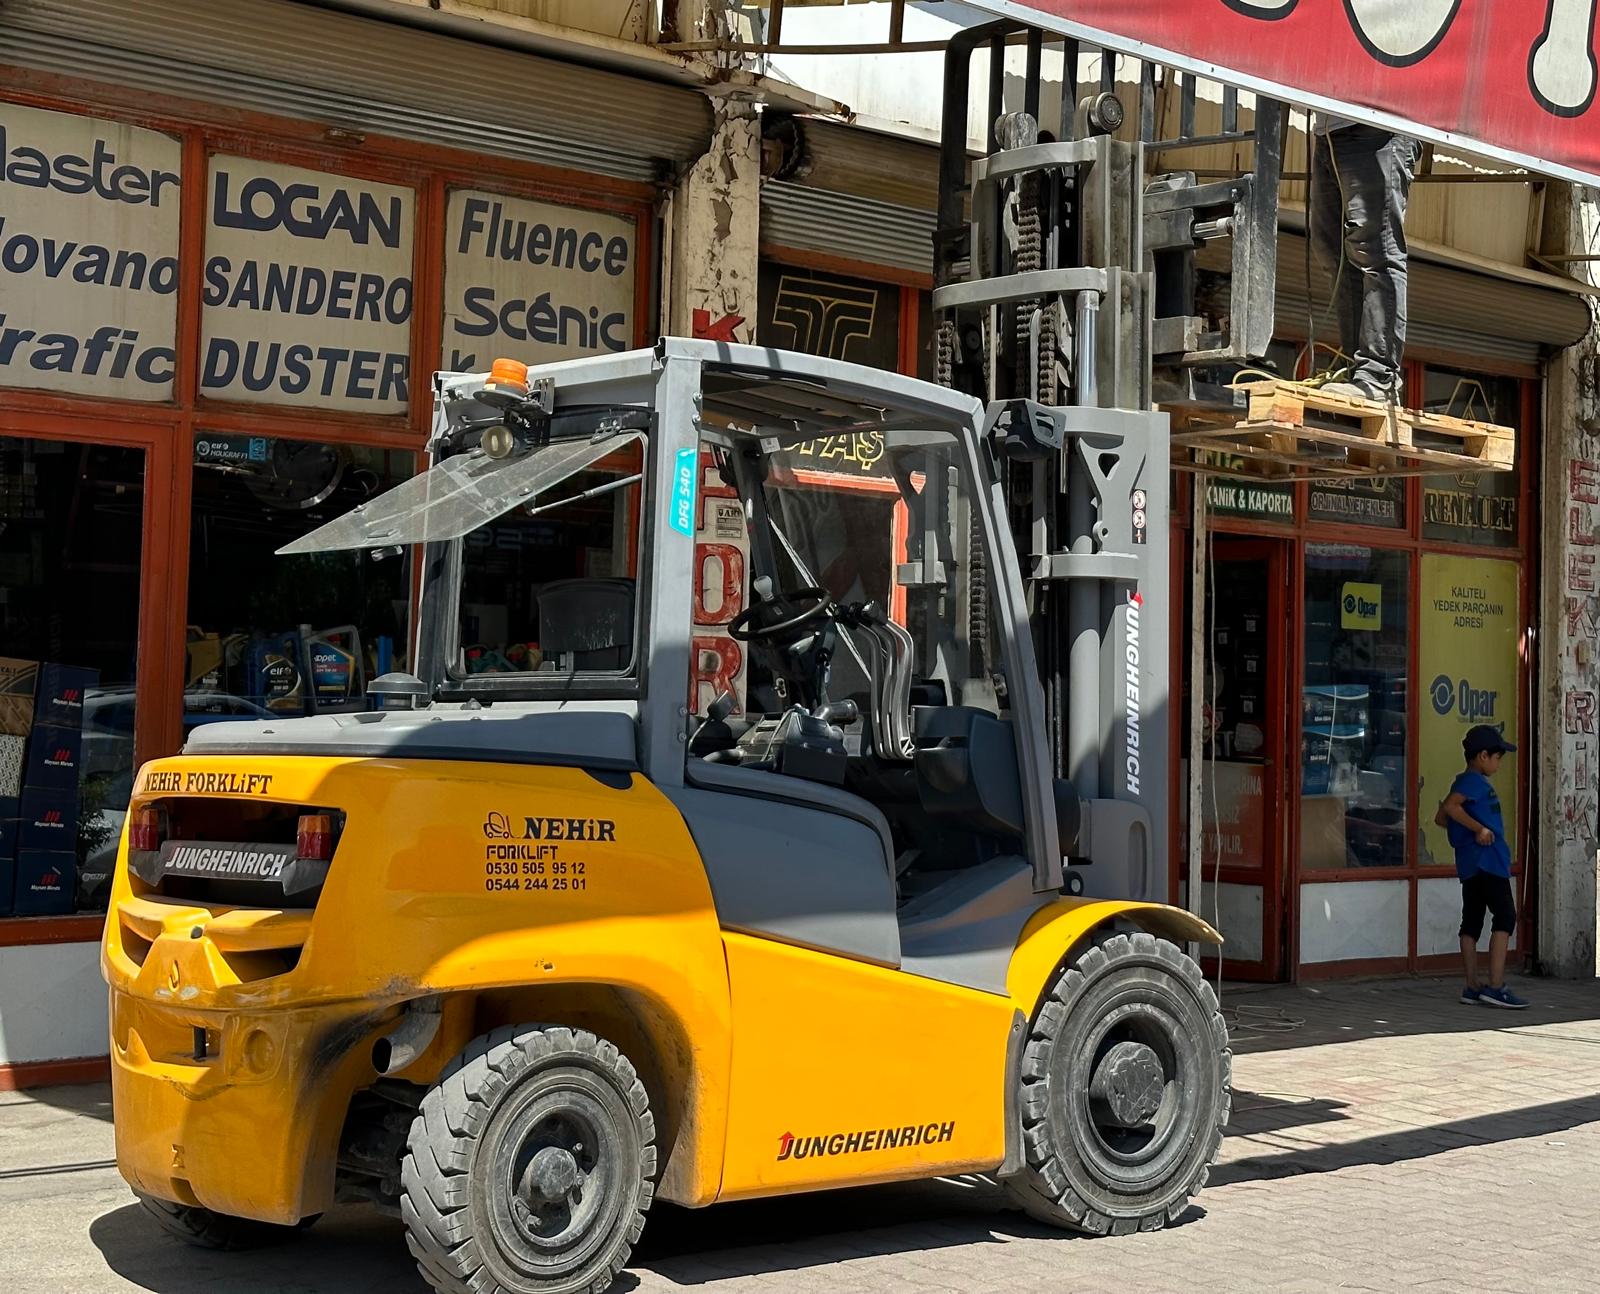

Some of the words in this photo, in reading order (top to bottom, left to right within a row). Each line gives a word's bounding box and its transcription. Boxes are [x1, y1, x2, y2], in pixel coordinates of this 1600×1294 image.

[0, 125, 180, 207] aster
[212, 171, 401, 249] LOGAN
[457, 198, 630, 278] Fluence
[0, 217, 178, 294] ovano
[203, 256, 413, 325] SANDERO
[453, 288, 627, 352] Scénic
[0, 314, 177, 383] rafic
[201, 338, 410, 401] DUSTER
[680, 467, 692, 498] 540
[678, 499, 690, 529] DFG
[1238, 489, 1246, 509] &
[1248, 491, 1293, 514] KAPORTA
[1423, 488, 1515, 531] RENAULT
[1357, 596, 1378, 618] Opar
[1433, 600, 1460, 612] YEDEK
[1462, 602, 1504, 617] PARÇANIN
[1453, 616, 1484, 629] ADRESi
[270, 667, 284, 676] elf
[1126, 588, 1142, 797] JUNGHEINRICH
[1458, 679, 1497, 723] Opar
[144, 772, 182, 792] NEHiR
[185, 773, 273, 795] FORKLiFT
[523, 816, 617, 842] NEHiR
[165, 846, 288, 878] JUNGHEINRICH
[485, 861, 519, 875] 0530
[522, 861, 546, 875] 505
[551, 861, 570, 875] 95
[571, 861, 586, 875] 12
[486, 845, 559, 860] FORKLIFT
[485, 878, 519, 891] 0544
[523, 878, 549, 891] 244
[551, 878, 570, 891] 25
[571, 878, 587, 891] 01
[776, 1120, 956, 1161] JUNGHEINRICH
